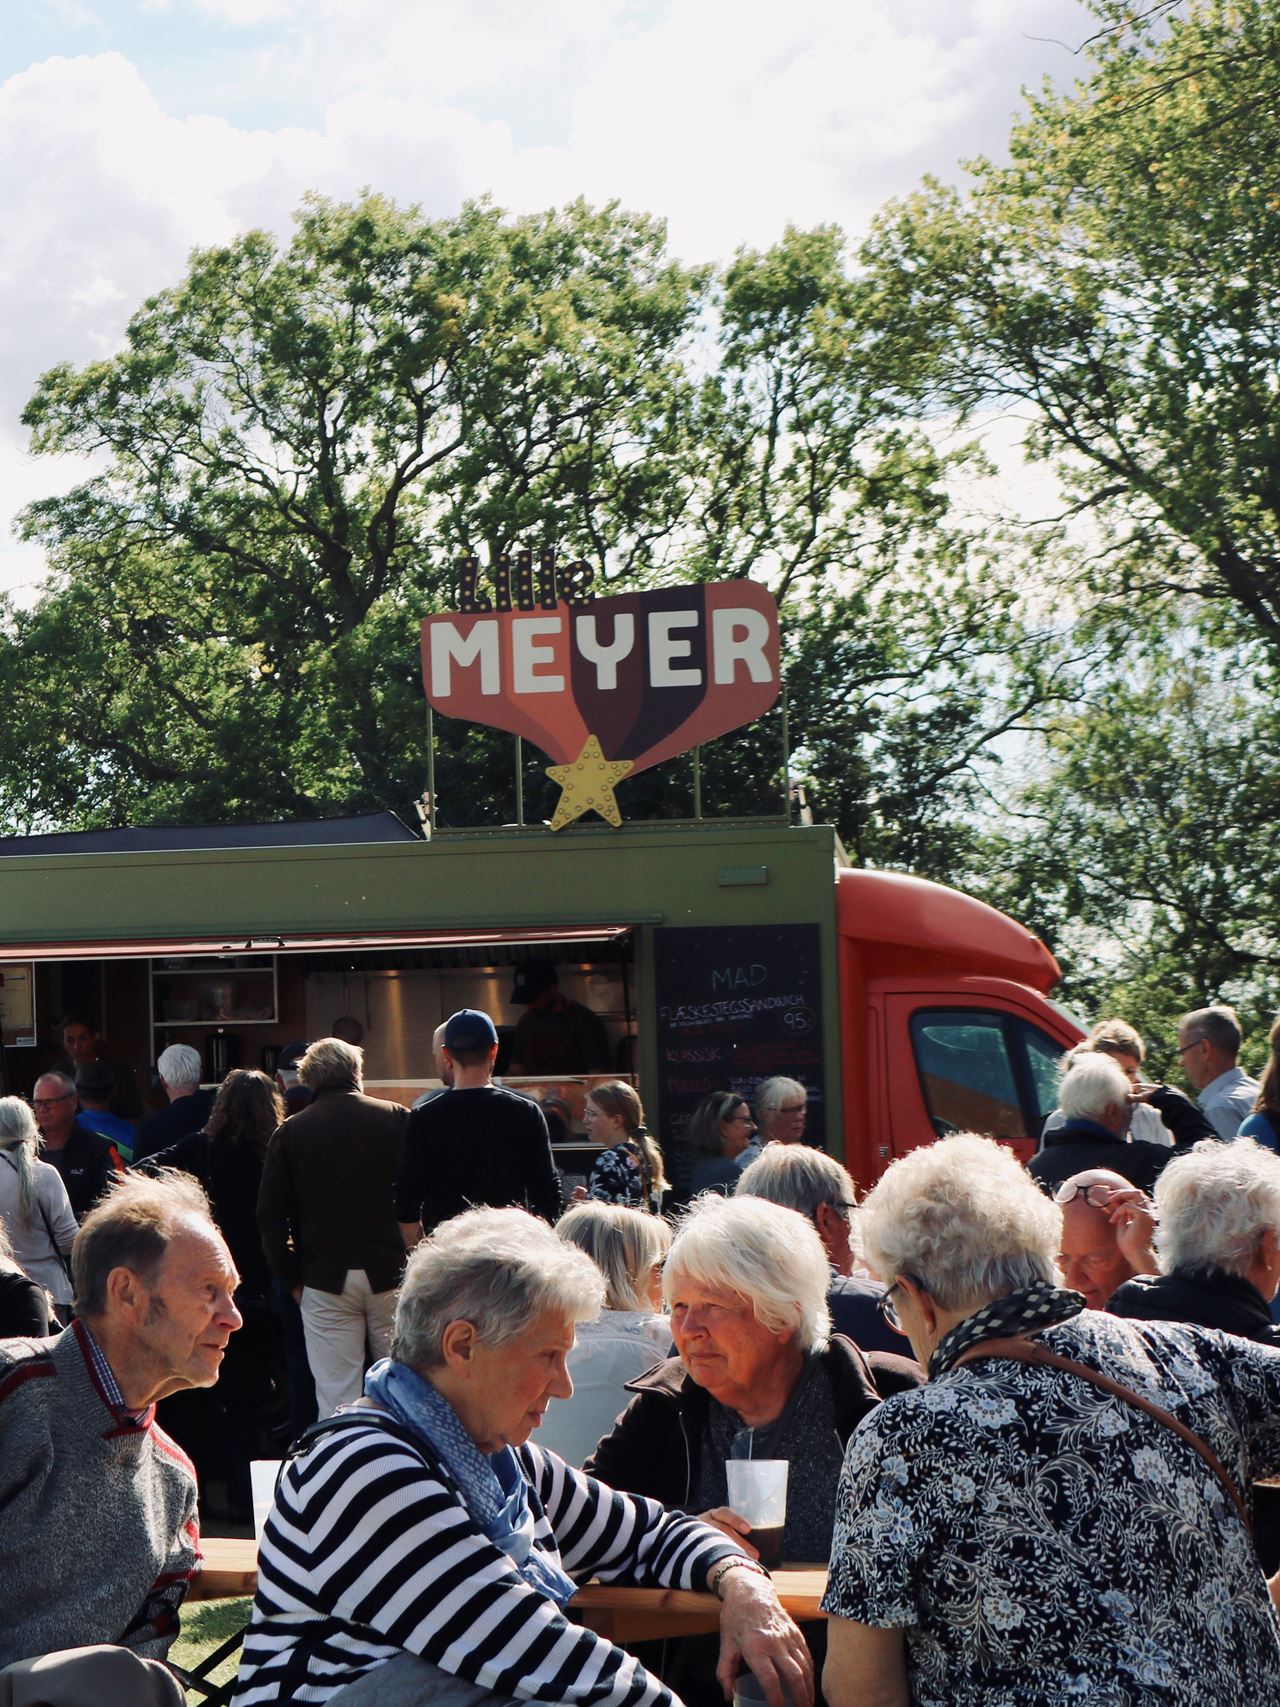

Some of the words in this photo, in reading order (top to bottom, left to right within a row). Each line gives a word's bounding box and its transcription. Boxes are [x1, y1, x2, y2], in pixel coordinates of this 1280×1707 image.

[460, 549, 595, 613] Lille
[430, 607, 773, 698] MEYER
[712, 964, 768, 992] MAD
